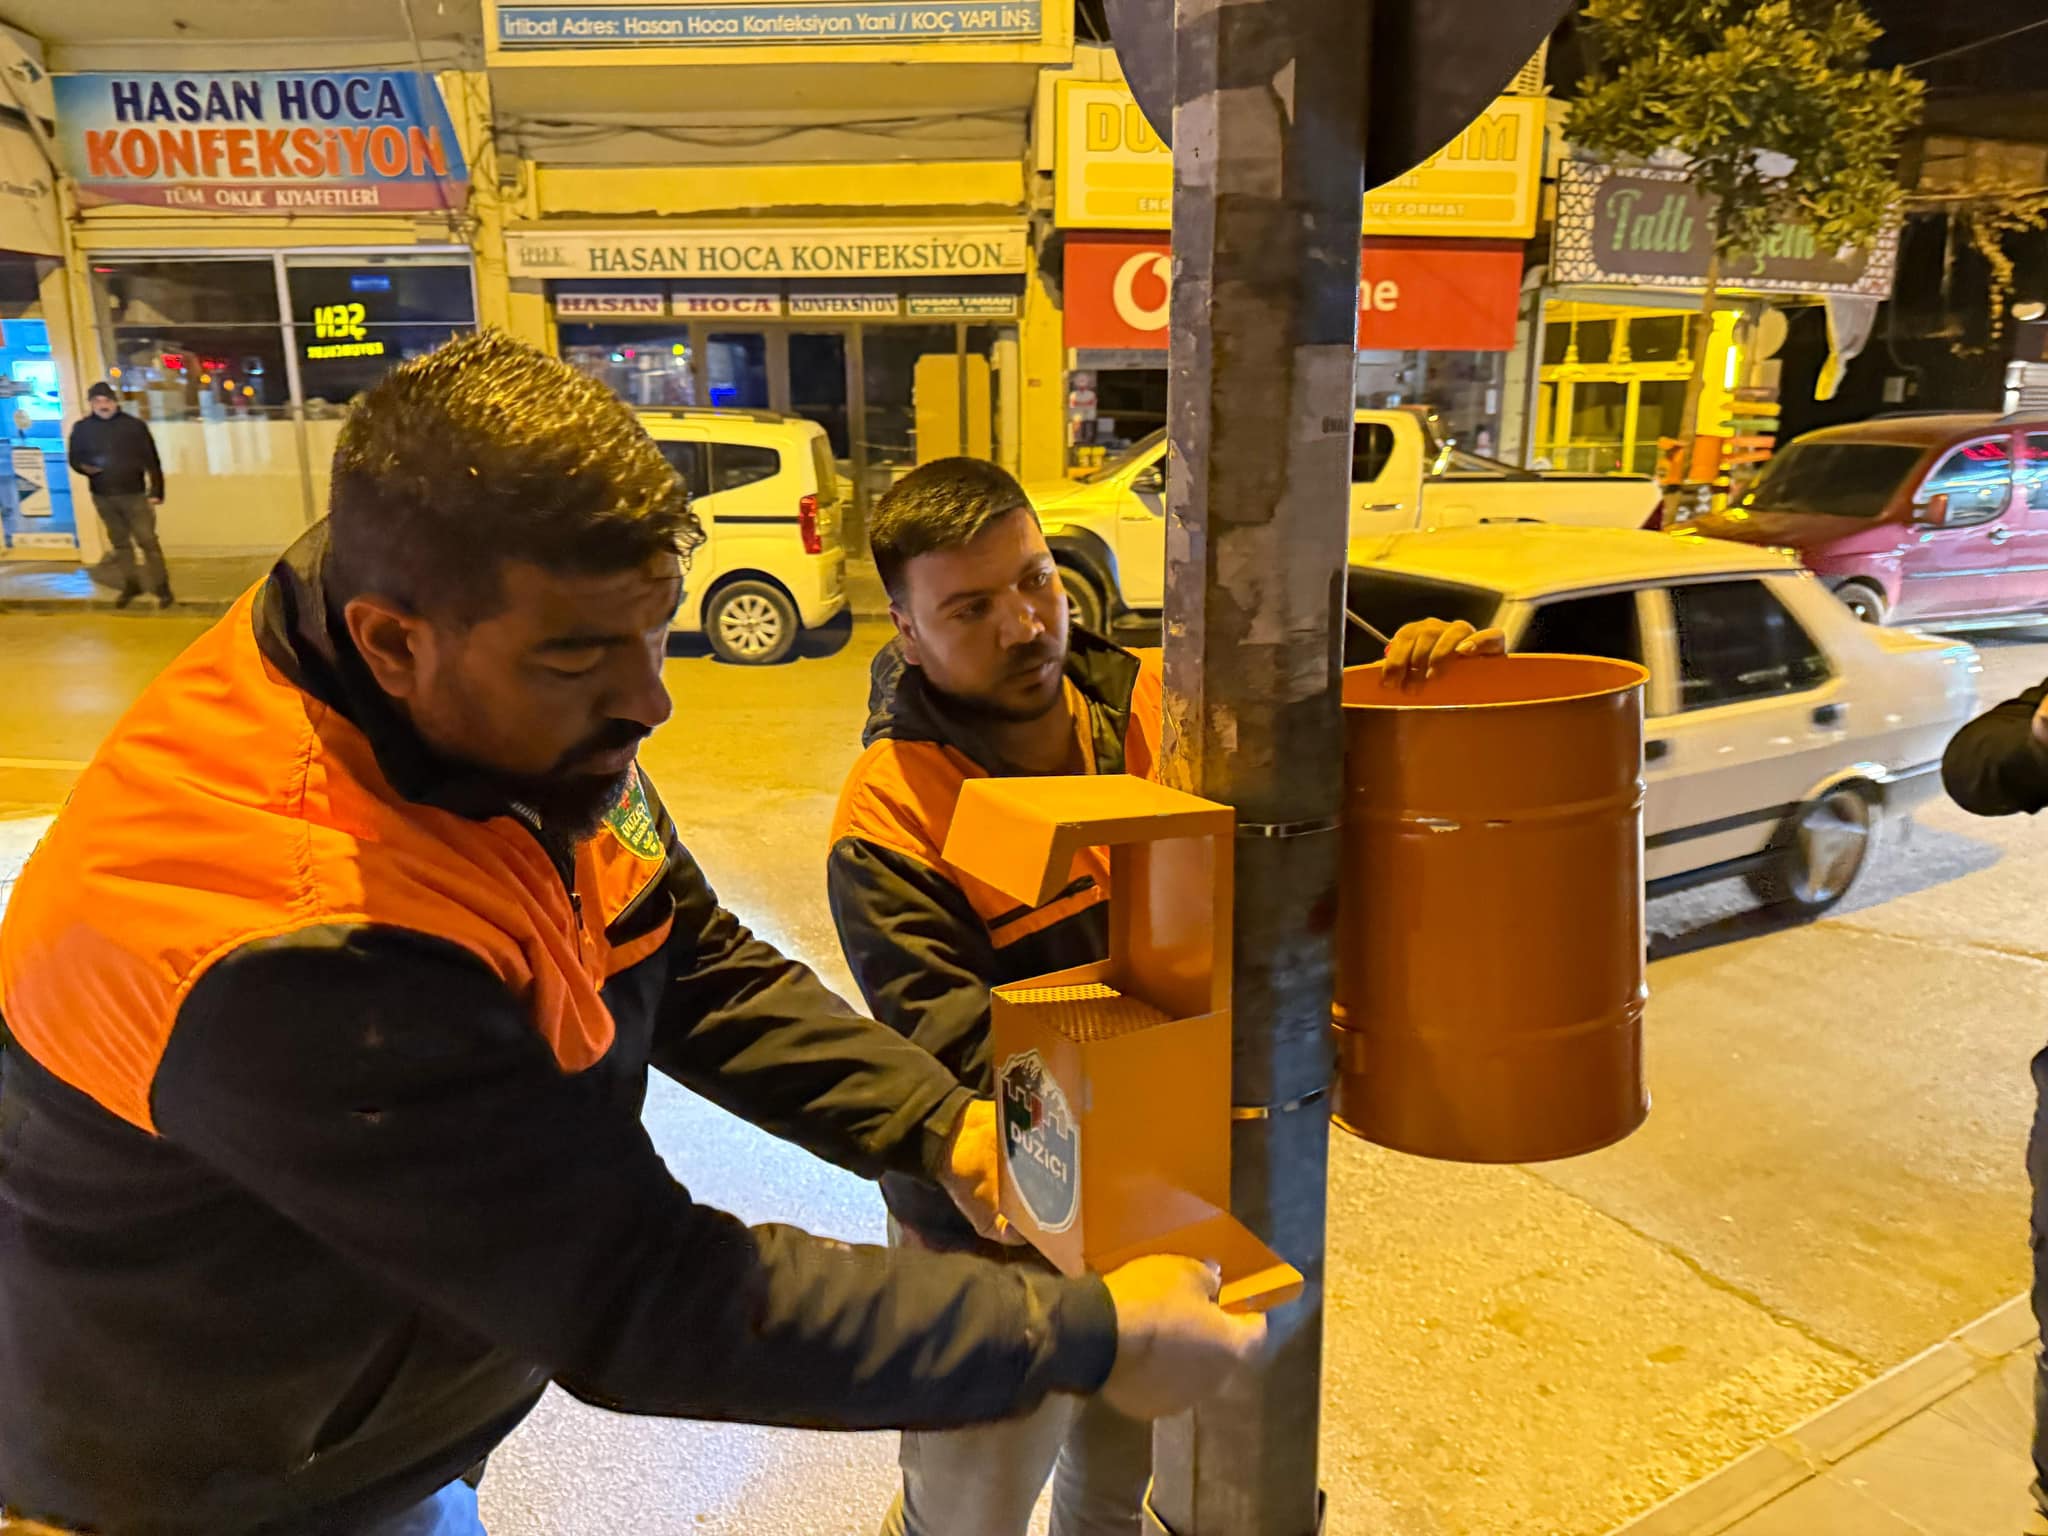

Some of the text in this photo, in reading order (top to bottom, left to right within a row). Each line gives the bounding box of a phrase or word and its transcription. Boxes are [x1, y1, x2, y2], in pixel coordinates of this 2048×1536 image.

[561, 17, 620, 36] Adres:
[624, 16, 683, 35] Hasan
[687, 15, 738, 34] Hoca
[743, 13, 851, 35] Konfeksiyon
[911, 10, 954, 34] KOÇ
[957, 10, 997, 29] YAPI
[111, 77, 405, 123] HASAN HOCA
[275, 185, 380, 207] KIYAFETLERİ
[589, 238, 1002, 272] HASAN HOCA KONFEKSİYON
[559, 295, 896, 313] HASAN HOCA KONFEKSİYON
